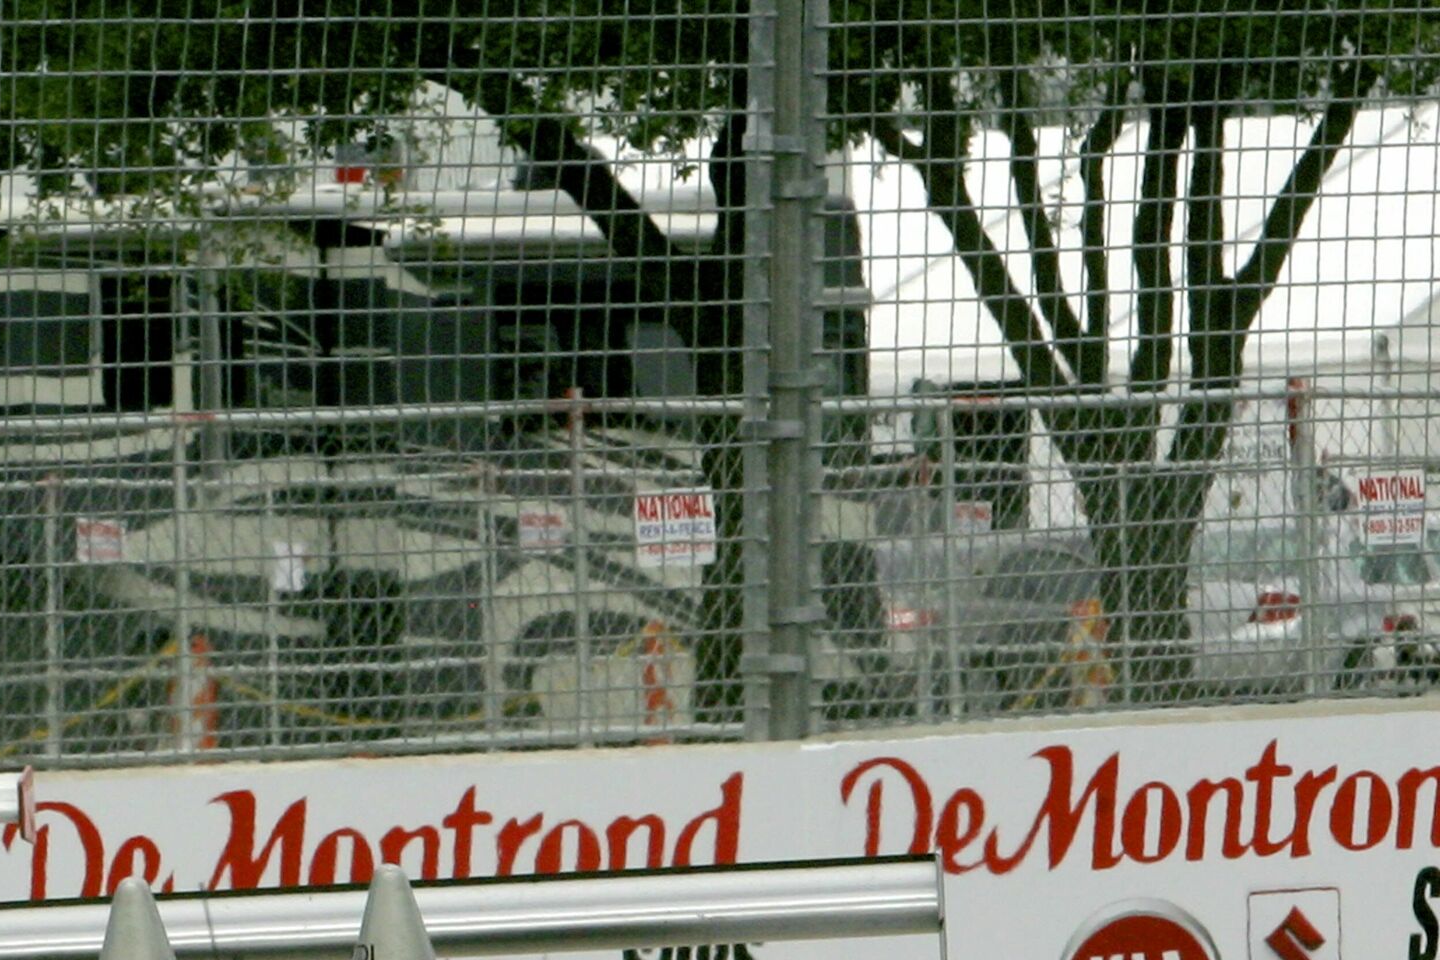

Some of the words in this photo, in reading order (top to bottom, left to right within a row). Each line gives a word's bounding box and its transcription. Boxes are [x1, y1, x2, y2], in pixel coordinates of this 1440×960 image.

[1359, 475, 1424, 501] NATIONAL
[638, 495, 712, 521] NATIONAL
[841, 739, 1440, 876] DeMontron
